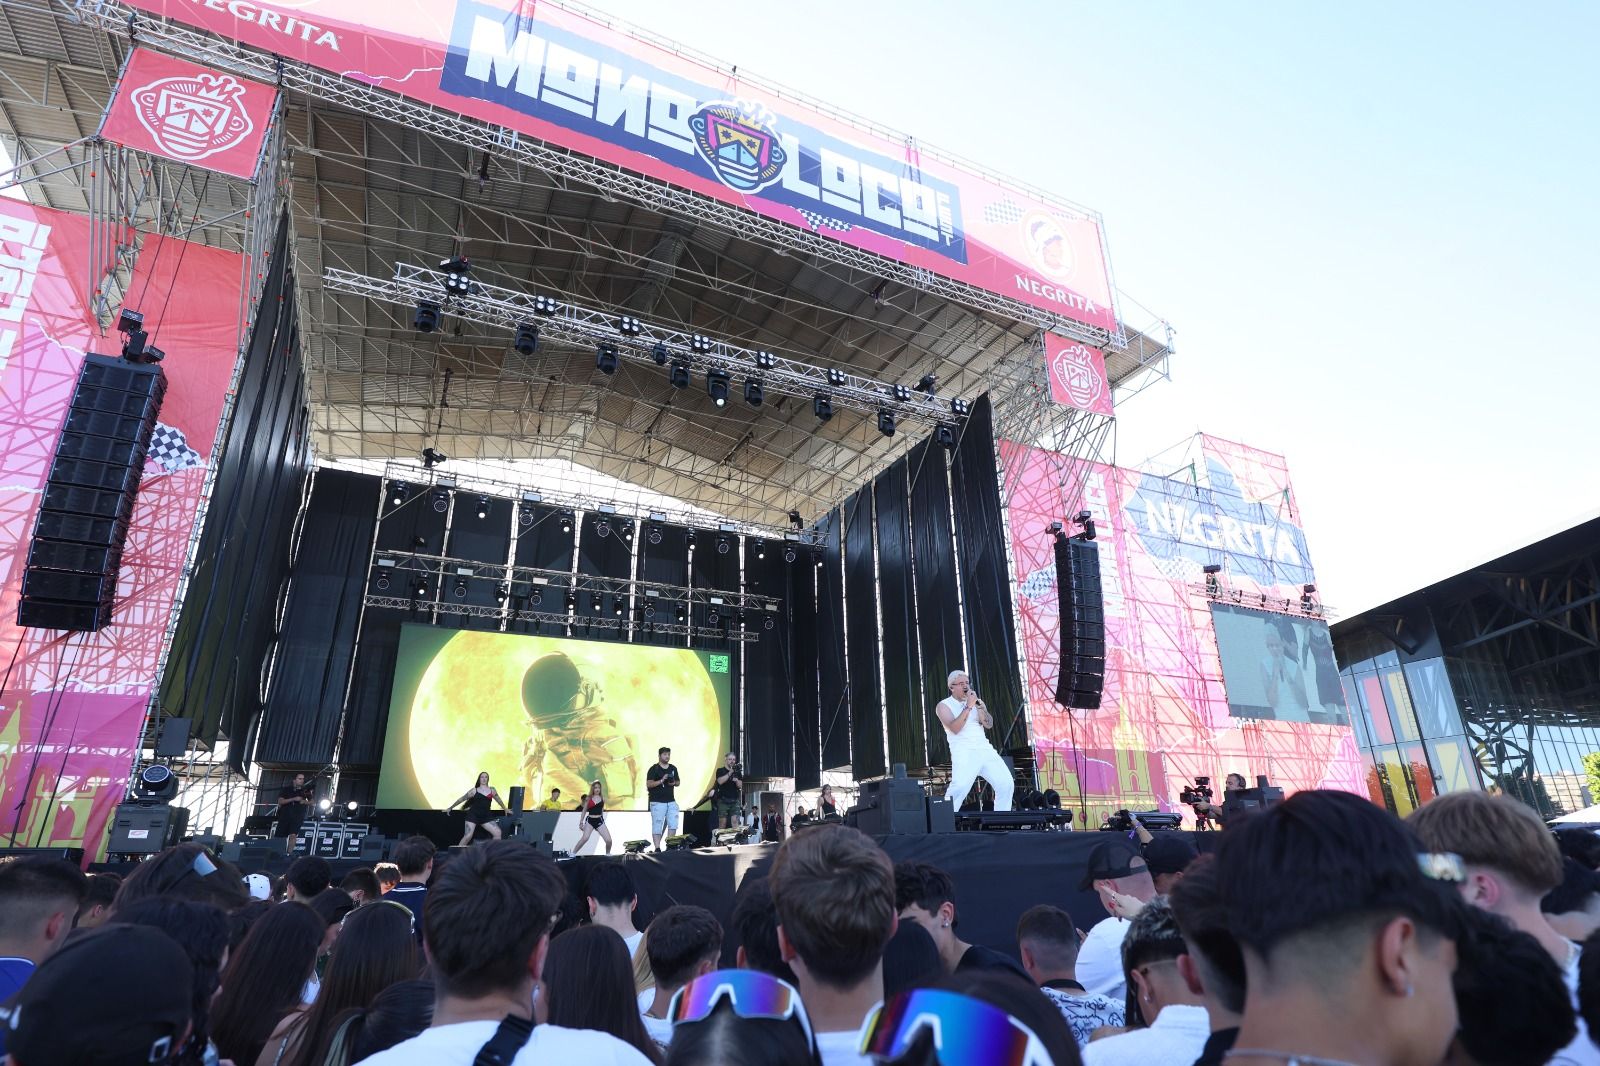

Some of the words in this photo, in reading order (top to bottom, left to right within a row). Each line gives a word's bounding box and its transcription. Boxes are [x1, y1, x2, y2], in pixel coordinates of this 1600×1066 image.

[465, 15, 698, 156] MONO
[782, 132, 940, 243] LOCO
[1015, 274, 1097, 314] NEGRITA
[1145, 498, 1304, 565] NEGRITA
